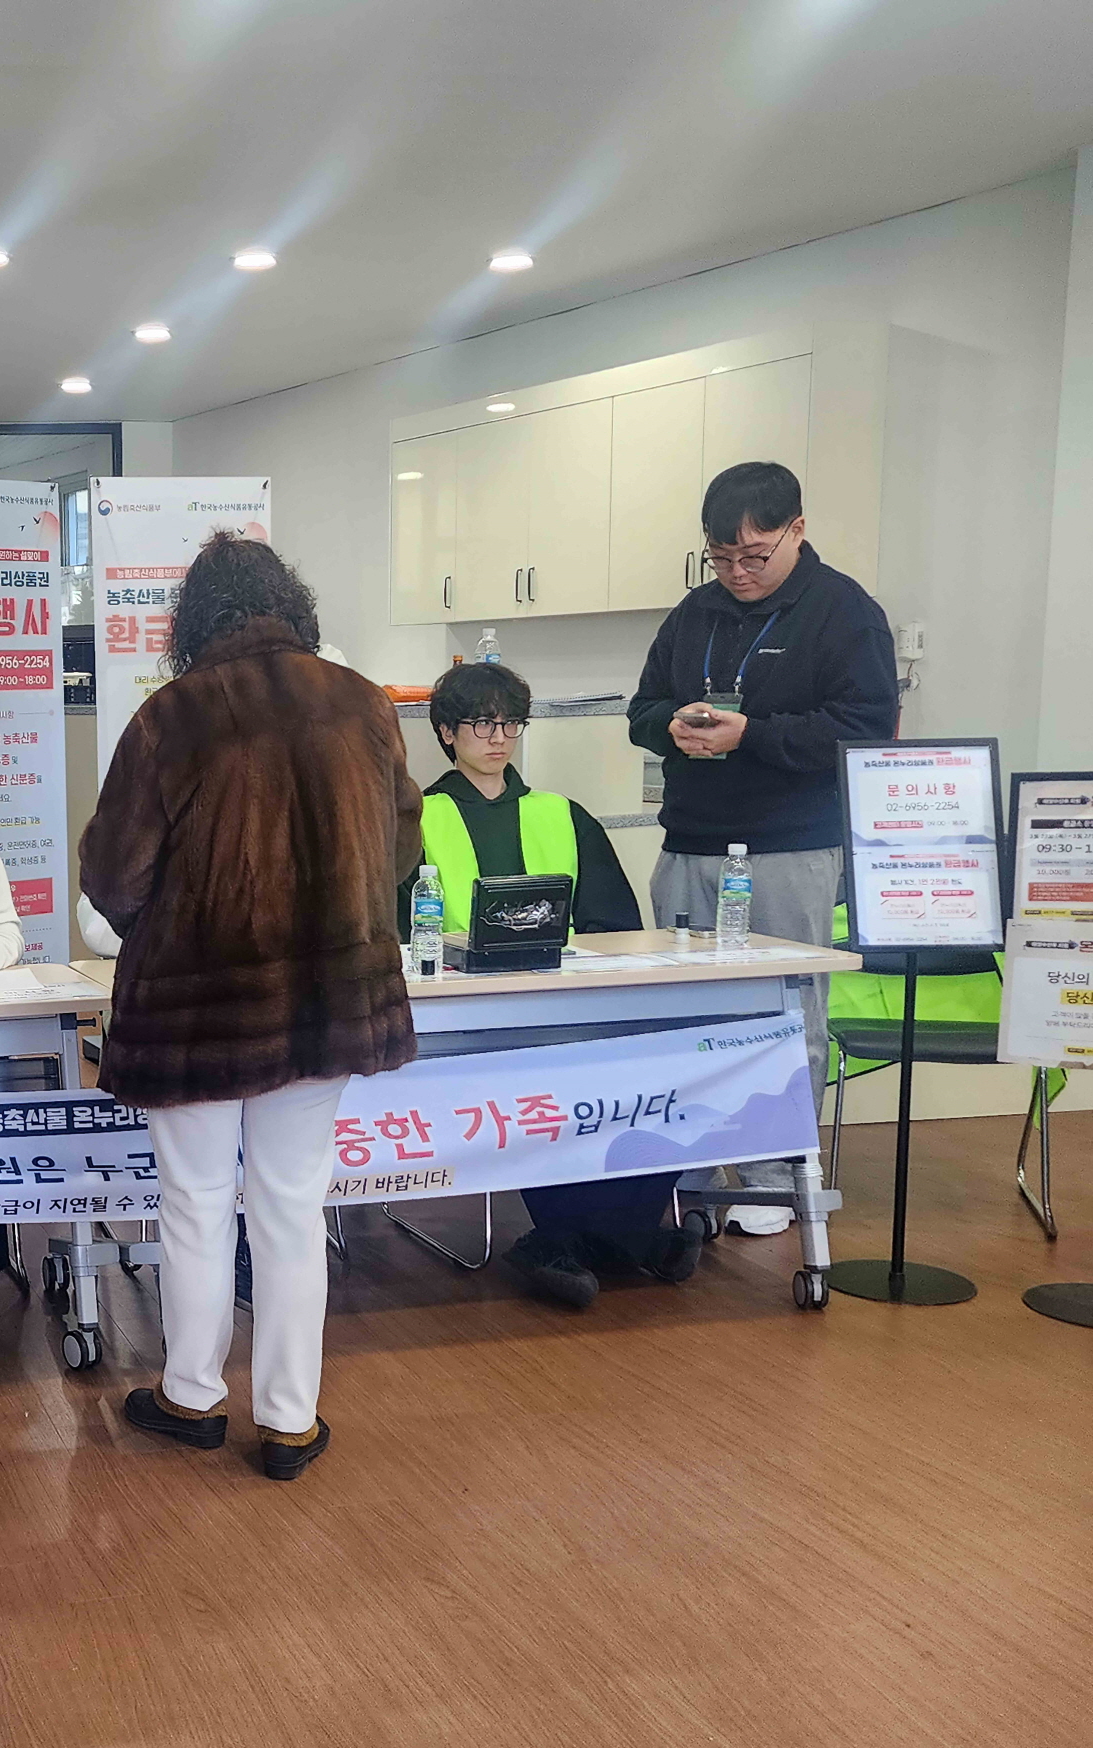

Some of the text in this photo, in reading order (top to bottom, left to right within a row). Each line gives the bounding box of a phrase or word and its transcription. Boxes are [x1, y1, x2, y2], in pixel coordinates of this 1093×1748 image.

[116, 504, 161, 512] 농림축산식품부
[200, 502, 265, 511] 한국농수산식품유통공사
[107, 588, 165, 606] 농축산물
[105, 614, 174, 654] 환급
[25, 675, 46, 684] 18:00
[3, 732, 38, 745] 농축산물
[12, 756, 18, 765] 및
[10, 772, 42, 786] 신분증을
[886, 802, 960, 812] 02-6956-2254
[1037, 844, 1073, 853] 09:30
[1048, 971, 1090, 985] 당신의
[1067, 991, 1093, 1005] 당신
[697, 1037, 715, 1052] aT
[83, 1152, 158, 1181] 누군
[335, 1110, 434, 1167] 중한
[454, 1088, 686, 1149] 가족입니다.
[50, 1195, 107, 1214] 지연될
[114, 1195, 134, 1210] 수
[328, 1178, 367, 1196] 시기
[375, 1169, 451, 1192] 바랍니다.
